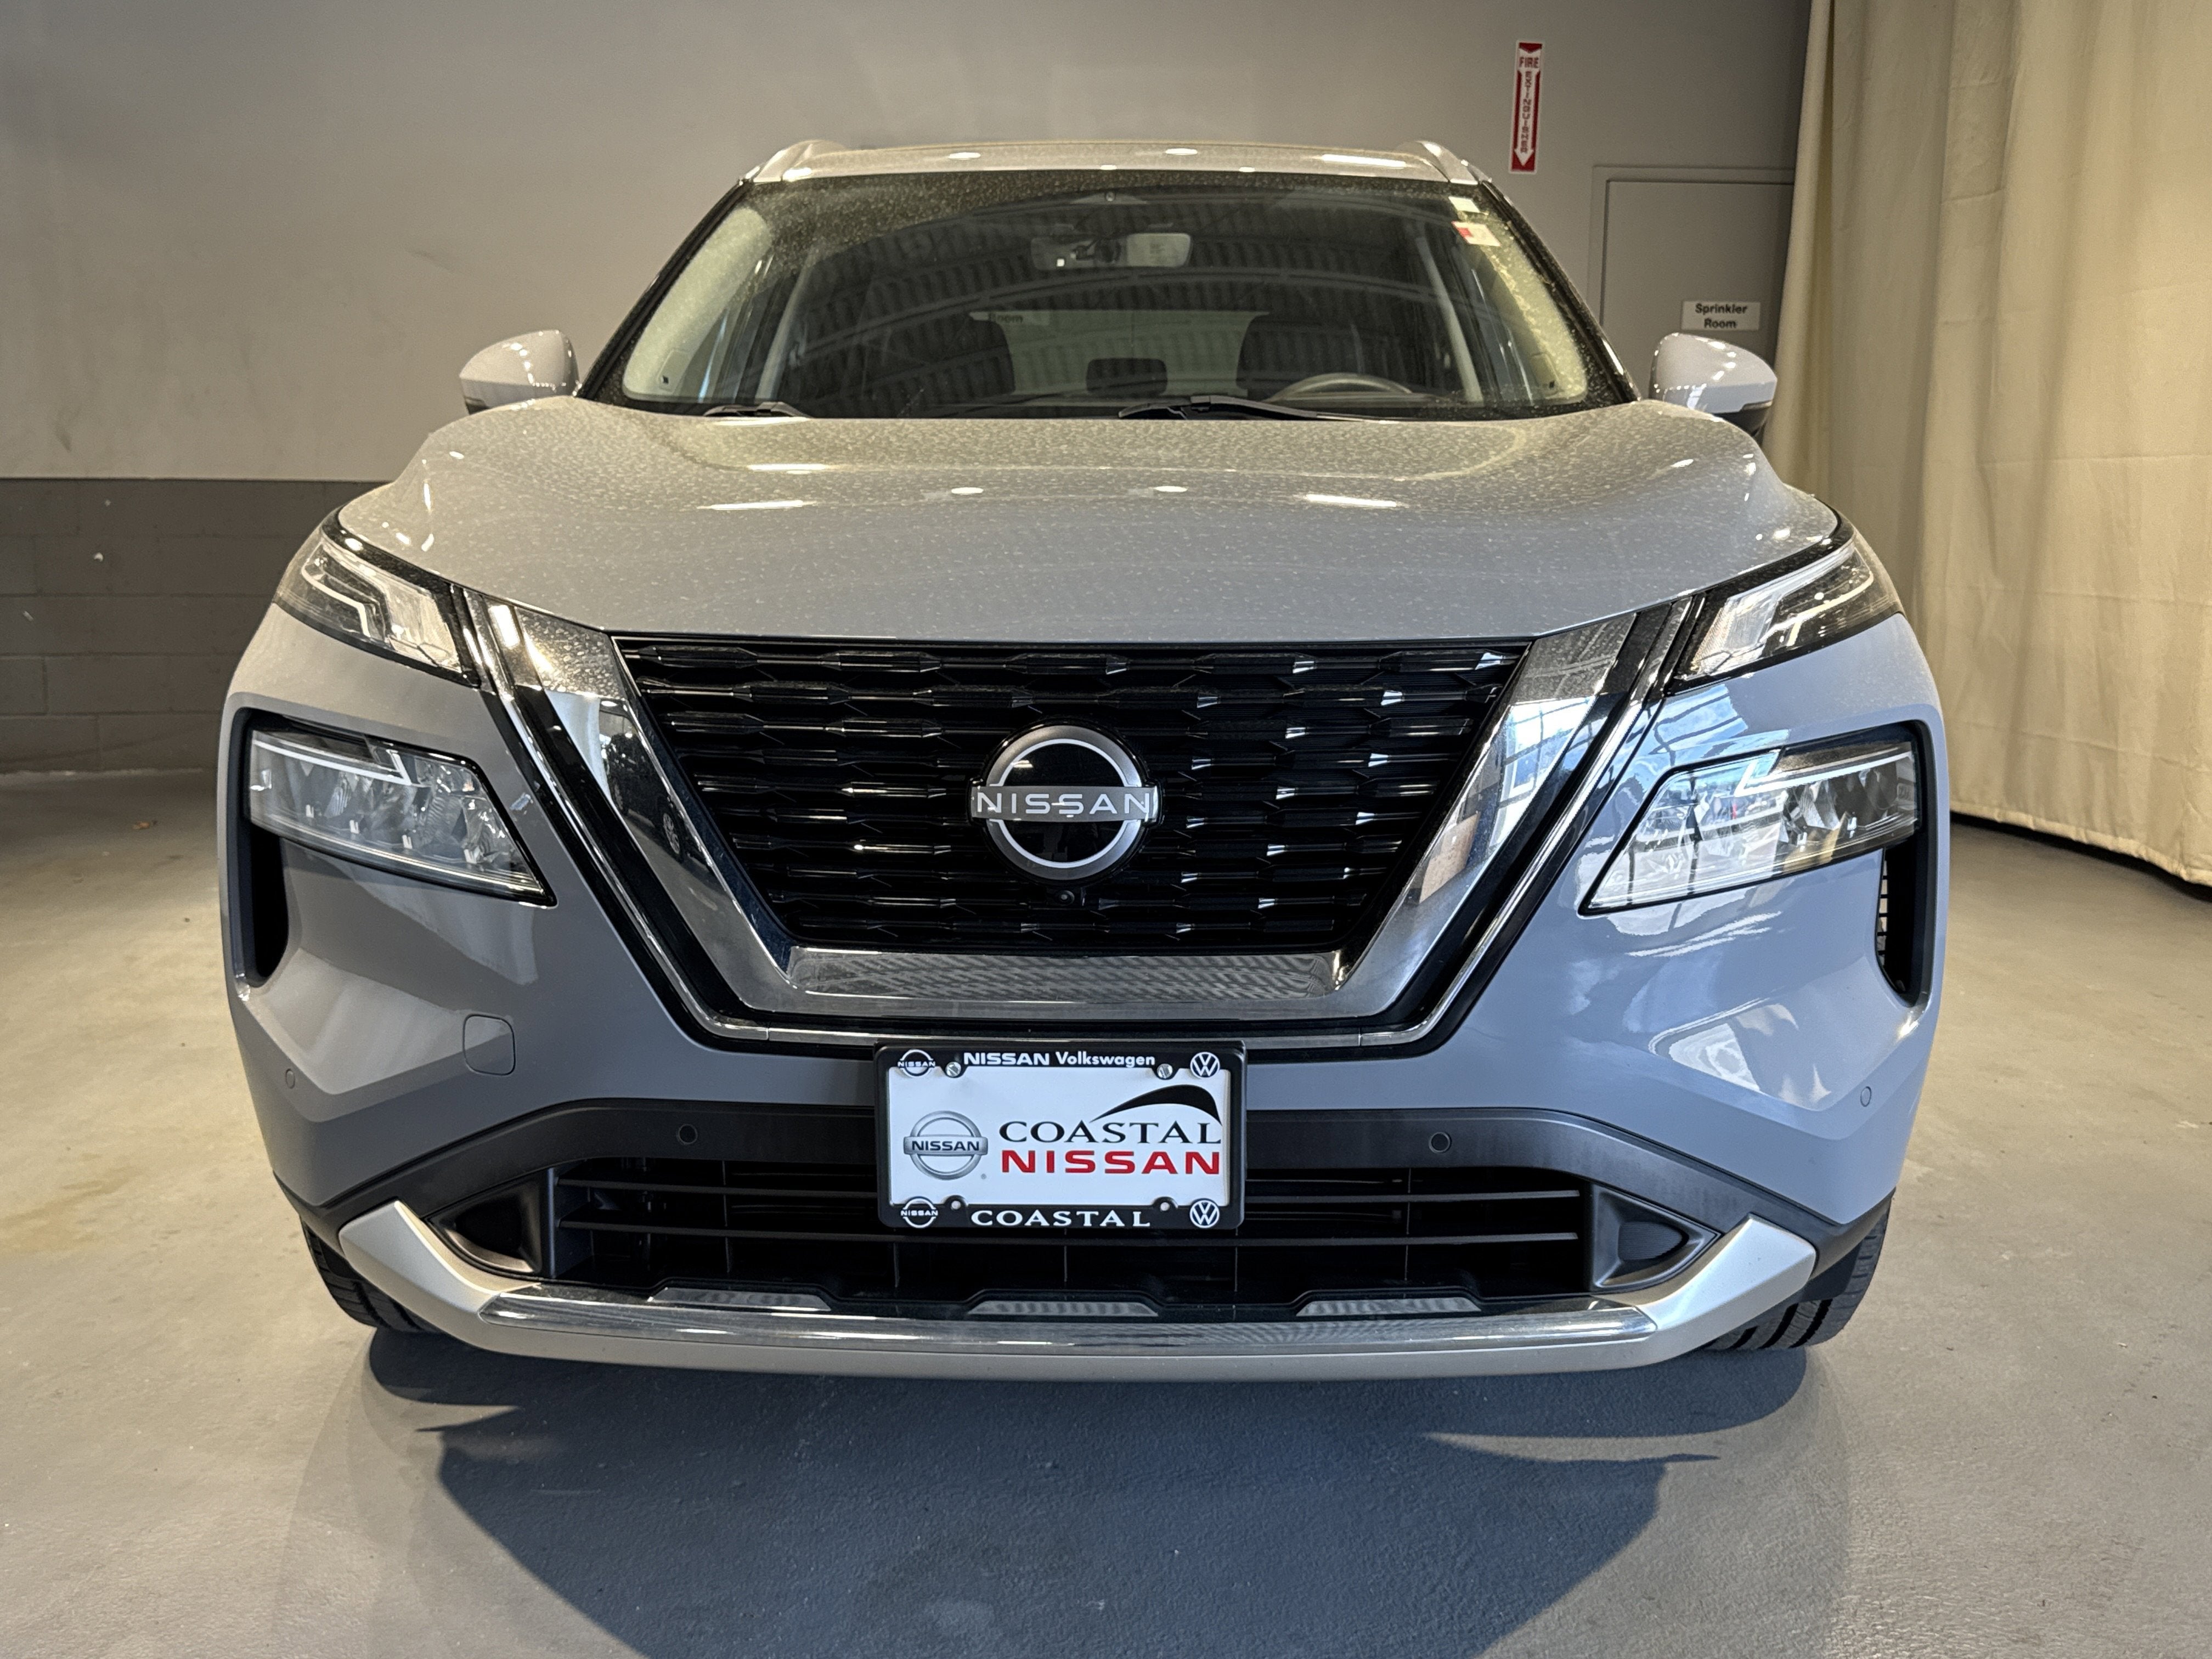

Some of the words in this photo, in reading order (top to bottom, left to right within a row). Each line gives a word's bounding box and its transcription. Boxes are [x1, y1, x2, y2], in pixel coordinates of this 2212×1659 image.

[1519, 57, 1539, 69] FIRE
[1520, 71, 1532, 153] EXTINGUISHER
[1695, 303, 1747, 315] Sprinkler
[1704, 318, 1736, 328] Room
[977, 792, 1150, 815] NISSAN
[964, 1052, 1049, 1066] NISSAN
[1055, 1051, 1155, 1068] Volkswagen
[998, 1119, 1222, 1144] COASTAL
[911, 1139, 980, 1152] NISSAN
[1001, 1150, 1220, 1175] NISSAN
[971, 1210, 1151, 1227] COASTAL
